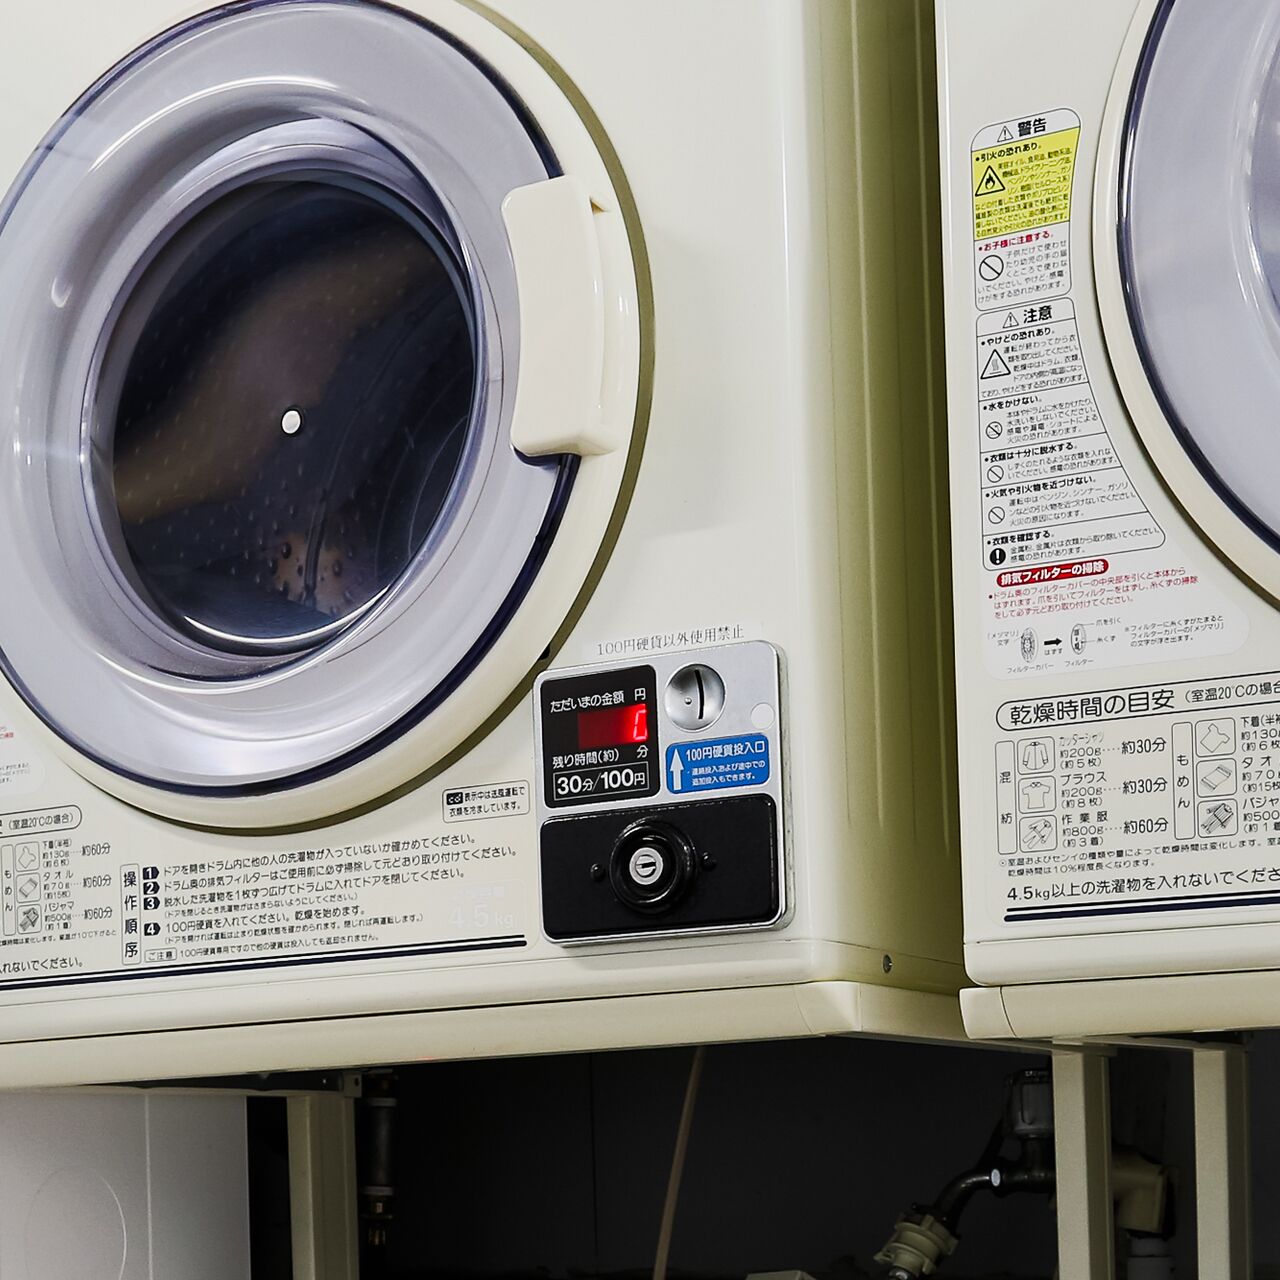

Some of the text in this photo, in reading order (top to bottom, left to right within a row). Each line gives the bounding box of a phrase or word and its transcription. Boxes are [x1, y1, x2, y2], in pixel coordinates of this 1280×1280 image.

[1017, 117, 1047, 137] 警告
[981, 141, 1041, 162] 引火の恐れあり。
[983, 230, 1053, 251] お子様に注意する。
[1023, 305, 1052, 324] 注意
[986, 327, 1055, 346] やけどの恐れあり。
[989, 395, 1042, 412] 水をかけない。
[989, 442, 1078, 463] 衣類は十分に脱水する。
[990, 476, 1097, 499] 火気や引火物を近づけない。
[992, 531, 1054, 546] 衣類を確認する。
[1001, 560, 1105, 586] 排気フィルターの掃除
[597, 625, 744, 655] 100円硬貨以外使用禁止
[550, 687, 646, 713] ただいまの金額 円
[1010, 689, 1175, 725] 乾燥時間の目安
[552, 745, 649, 767] 残り時間(約) 分
[1122, 737, 1167, 755] 約30分
[556, 769, 646, 795] 30分/100円
[1060, 771, 1108, 786] ブラウス
[1122, 777, 1168, 794] 約30分
[1176, 754, 1189, 809] もめん
[1061, 810, 1108, 825] 作業服
[1123, 817, 1169, 835] 約60分
[81, 842, 111, 856] 約60分
[82, 875, 112, 888] 約60分
[84, 907, 113, 920] 約60分
[123, 871, 138, 958] 操作順序
